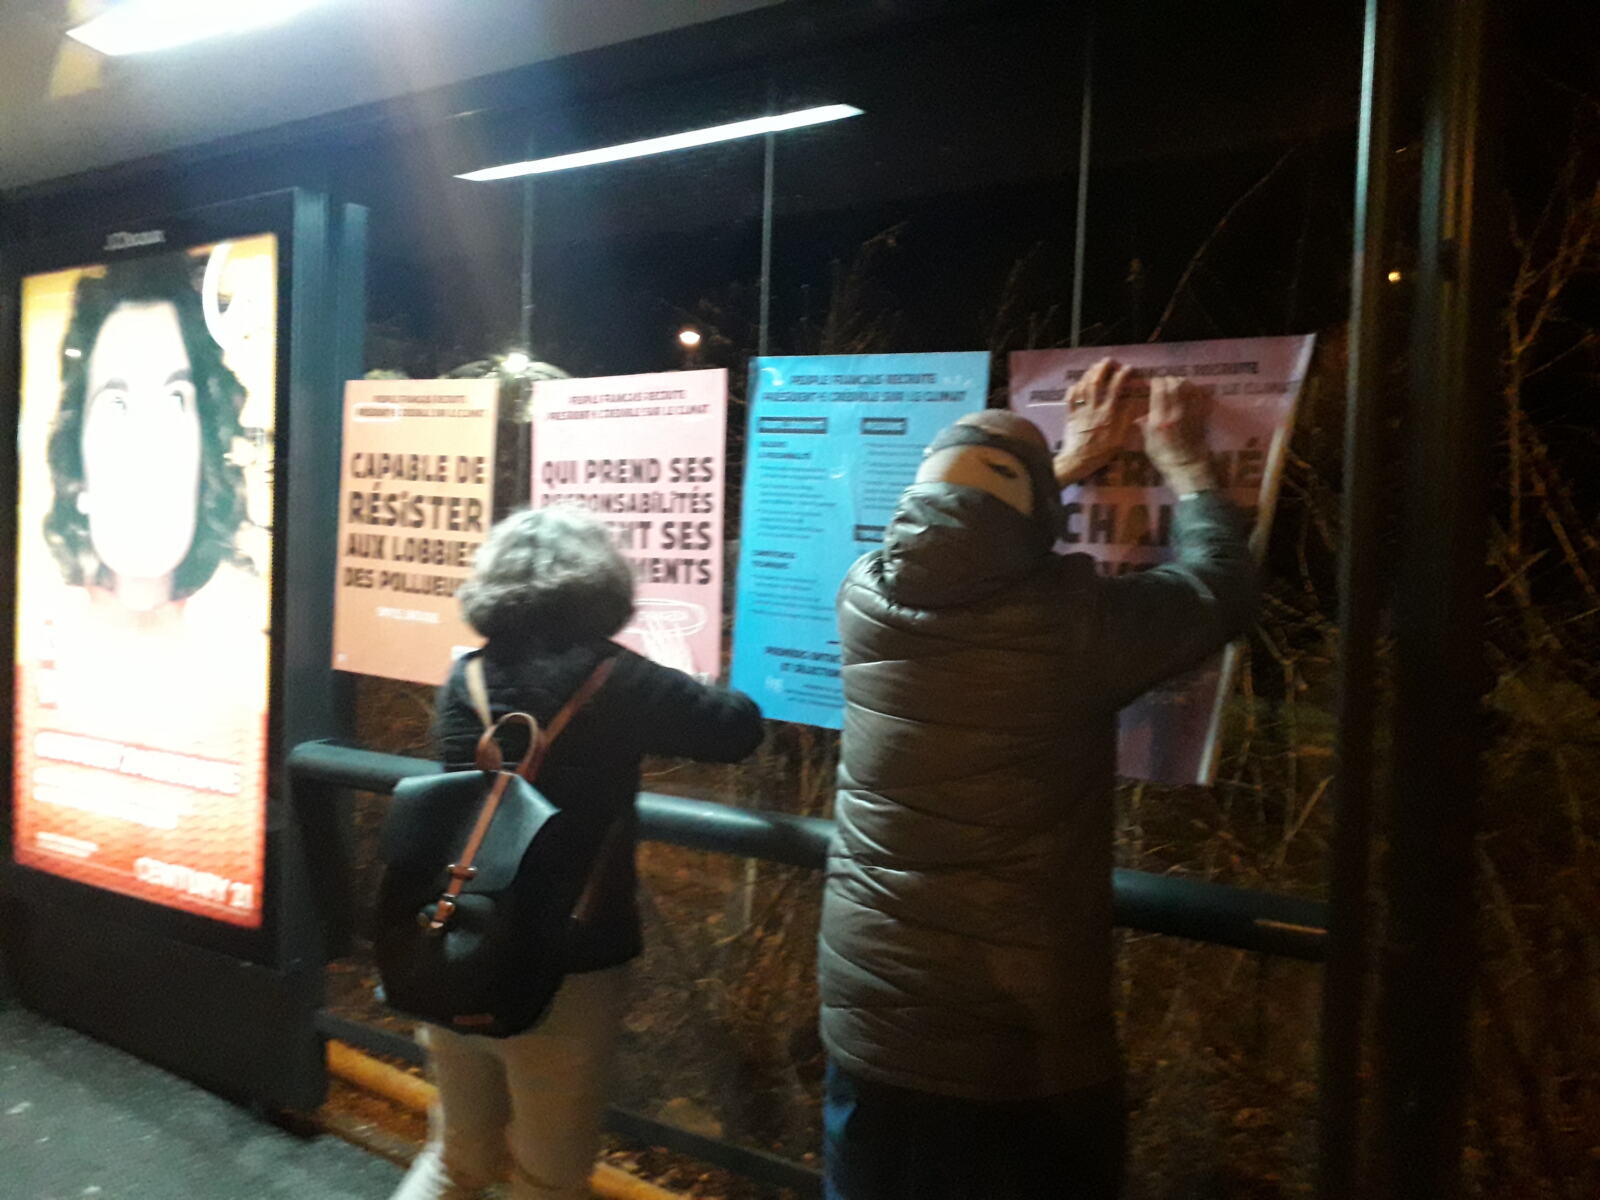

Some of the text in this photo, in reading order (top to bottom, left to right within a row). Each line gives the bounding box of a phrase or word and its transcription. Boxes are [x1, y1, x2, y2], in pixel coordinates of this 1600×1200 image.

[350, 453, 485, 484] CAPABLE DE
[541, 457, 714, 488] QUI PREND SES
[345, 533, 385, 560] AUX
[661, 521, 712, 550] SES
[344, 567, 374, 588] DES
